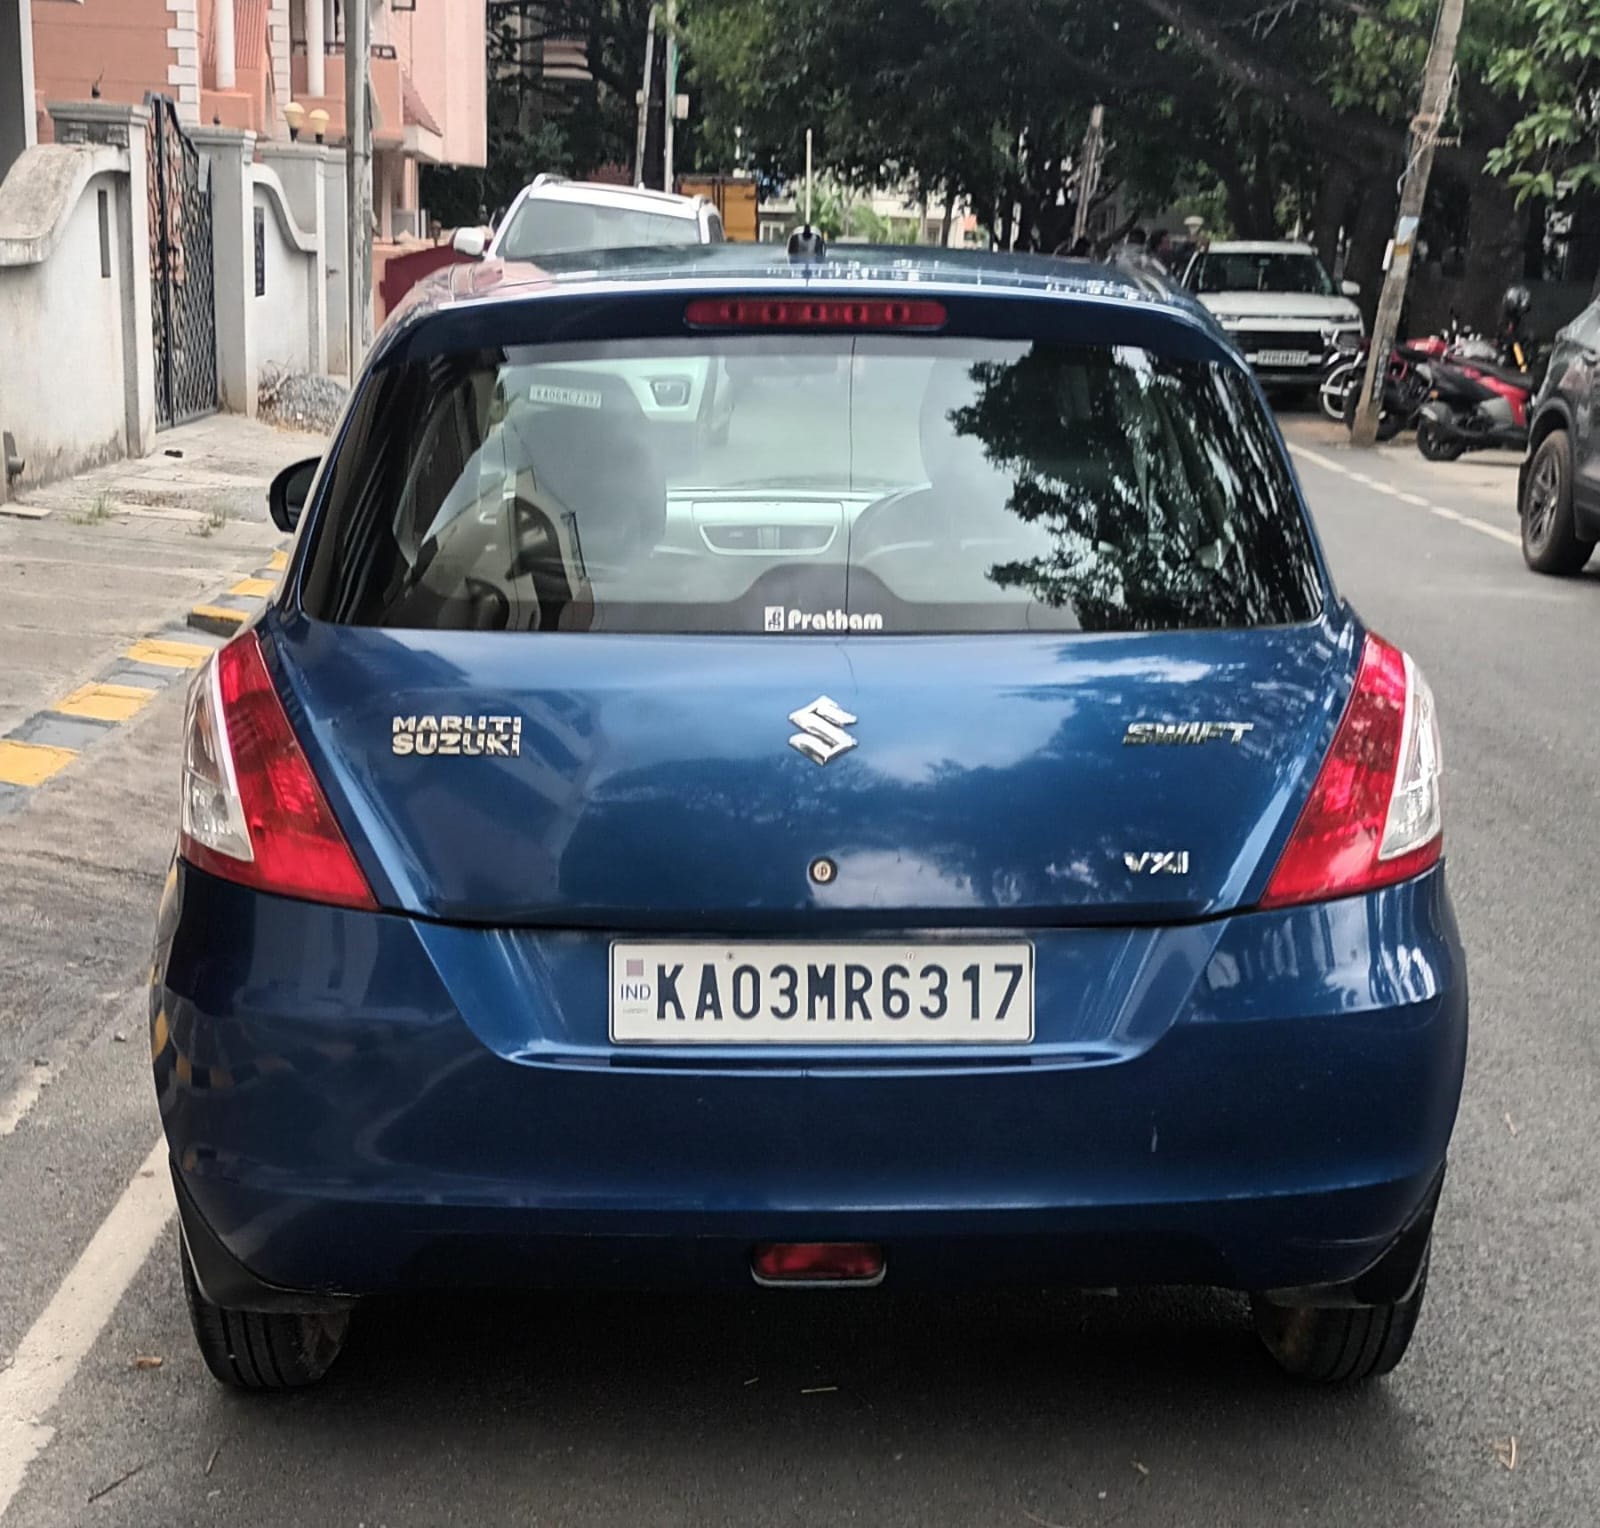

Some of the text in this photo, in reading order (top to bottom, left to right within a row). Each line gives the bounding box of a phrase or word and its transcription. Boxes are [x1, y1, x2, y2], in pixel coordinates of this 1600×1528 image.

[788, 609, 883, 630] Pratham
[392, 715, 522, 733] MARUTI
[1123, 721, 1254, 744] SWIFT
[392, 733, 521, 755] SUZUKI
[1123, 851, 1189, 874] VXI
[620, 984, 651, 1001] IND
[656, 963, 1024, 1021] KA03MR6317
